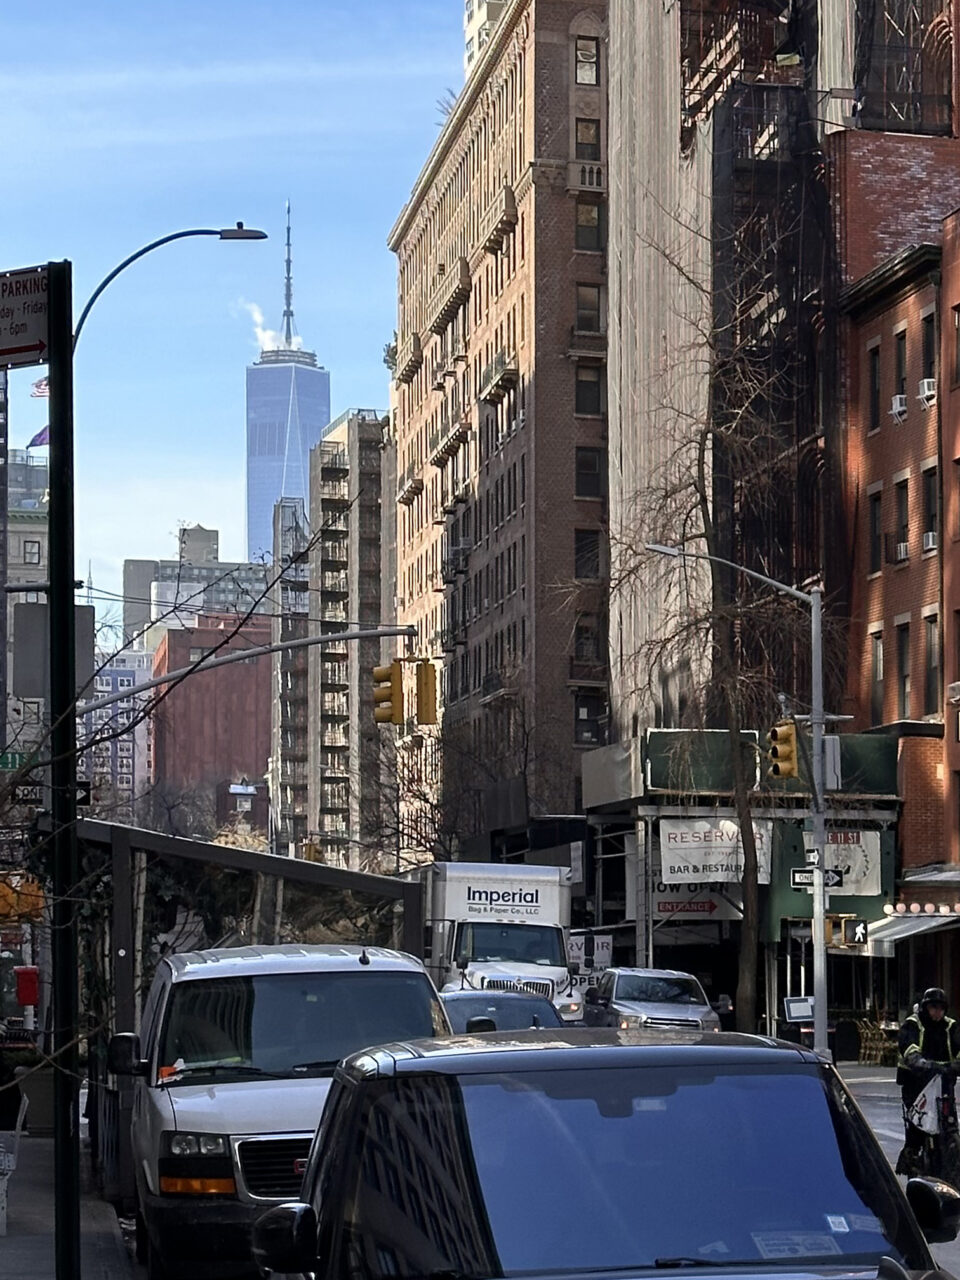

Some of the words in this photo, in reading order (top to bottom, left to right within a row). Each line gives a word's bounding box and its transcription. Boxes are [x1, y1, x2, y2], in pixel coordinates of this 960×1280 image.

[1, 276, 48, 298] PARKING
[837, 833, 845, 844] 11
[848, 833, 858, 844] ST
[669, 865, 689, 874] BAR
[692, 865, 700, 873] &
[798, 874, 814, 882] ONE
[467, 886, 539, 906] Imperial
[468, 906, 482, 914] Bag
